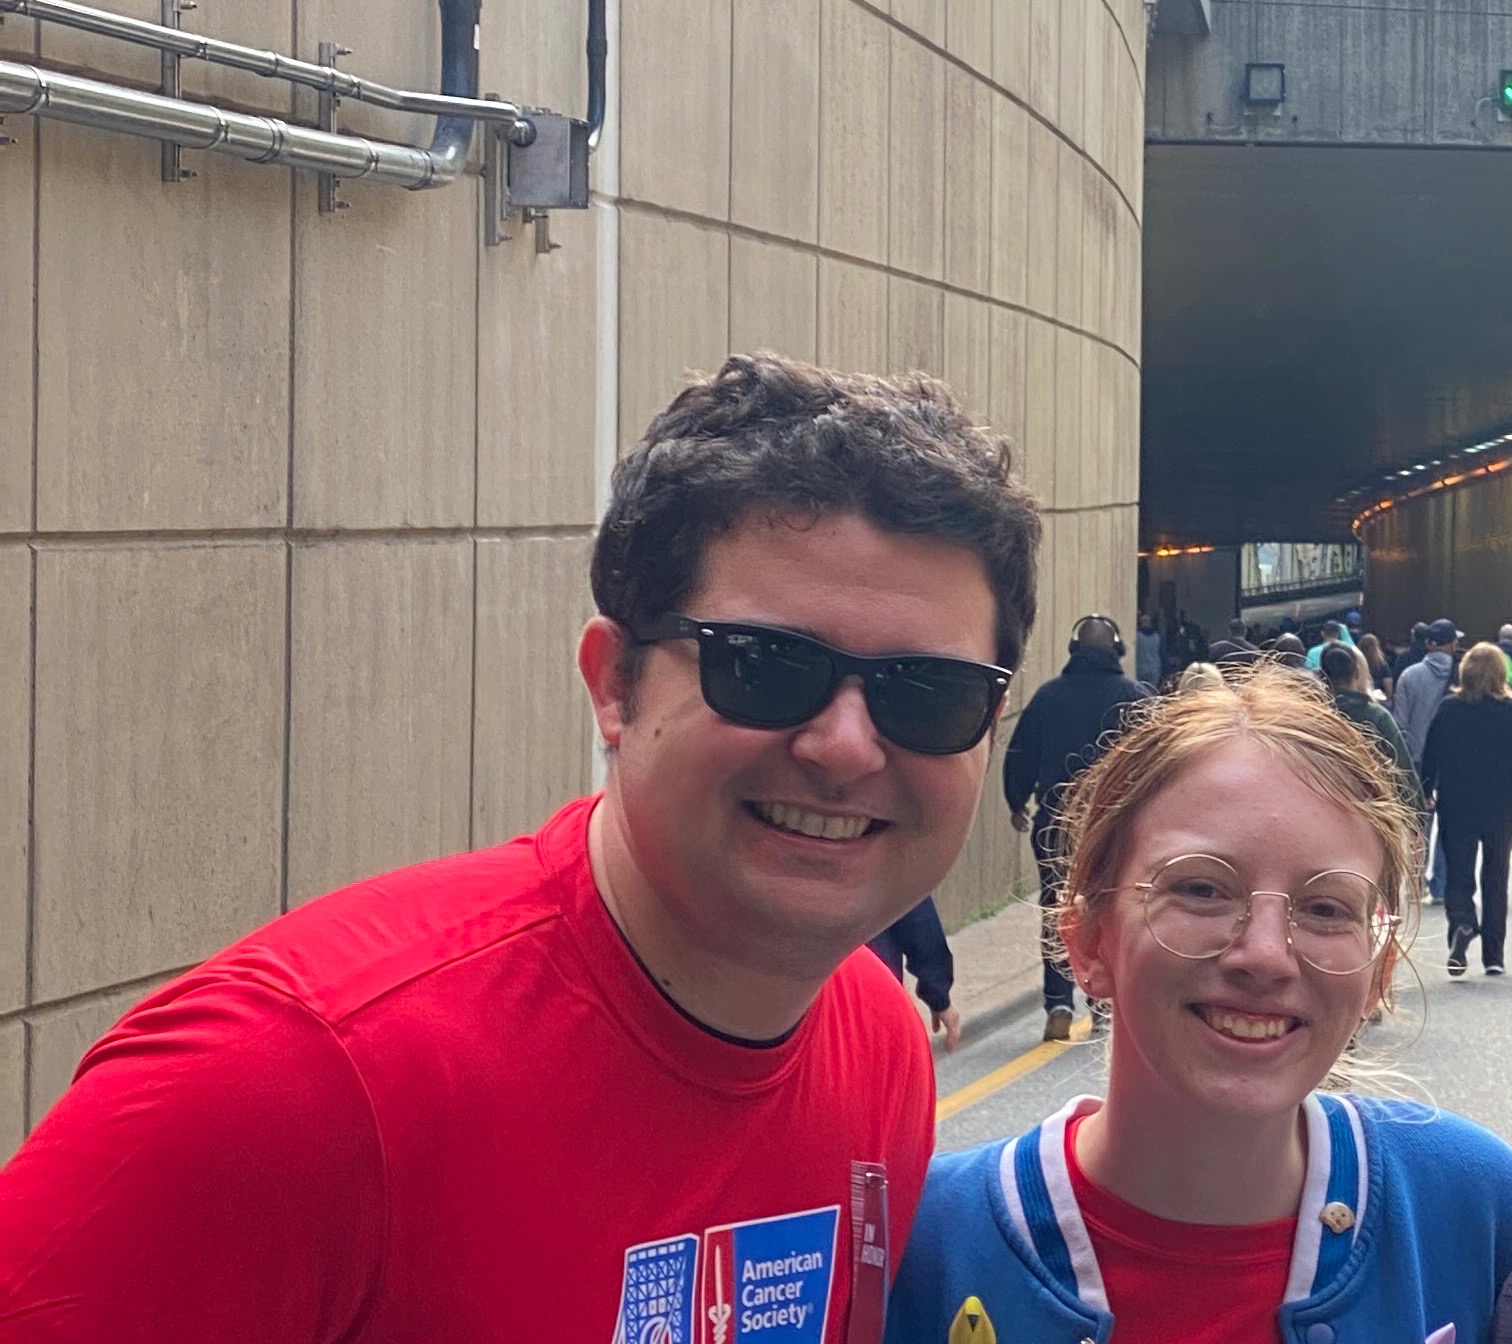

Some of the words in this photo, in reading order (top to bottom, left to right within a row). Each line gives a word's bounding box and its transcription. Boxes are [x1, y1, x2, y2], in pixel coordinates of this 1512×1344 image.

[741, 1250, 823, 1283] American
[741, 1280, 804, 1307] Cancer
[741, 1303, 808, 1333] Society
